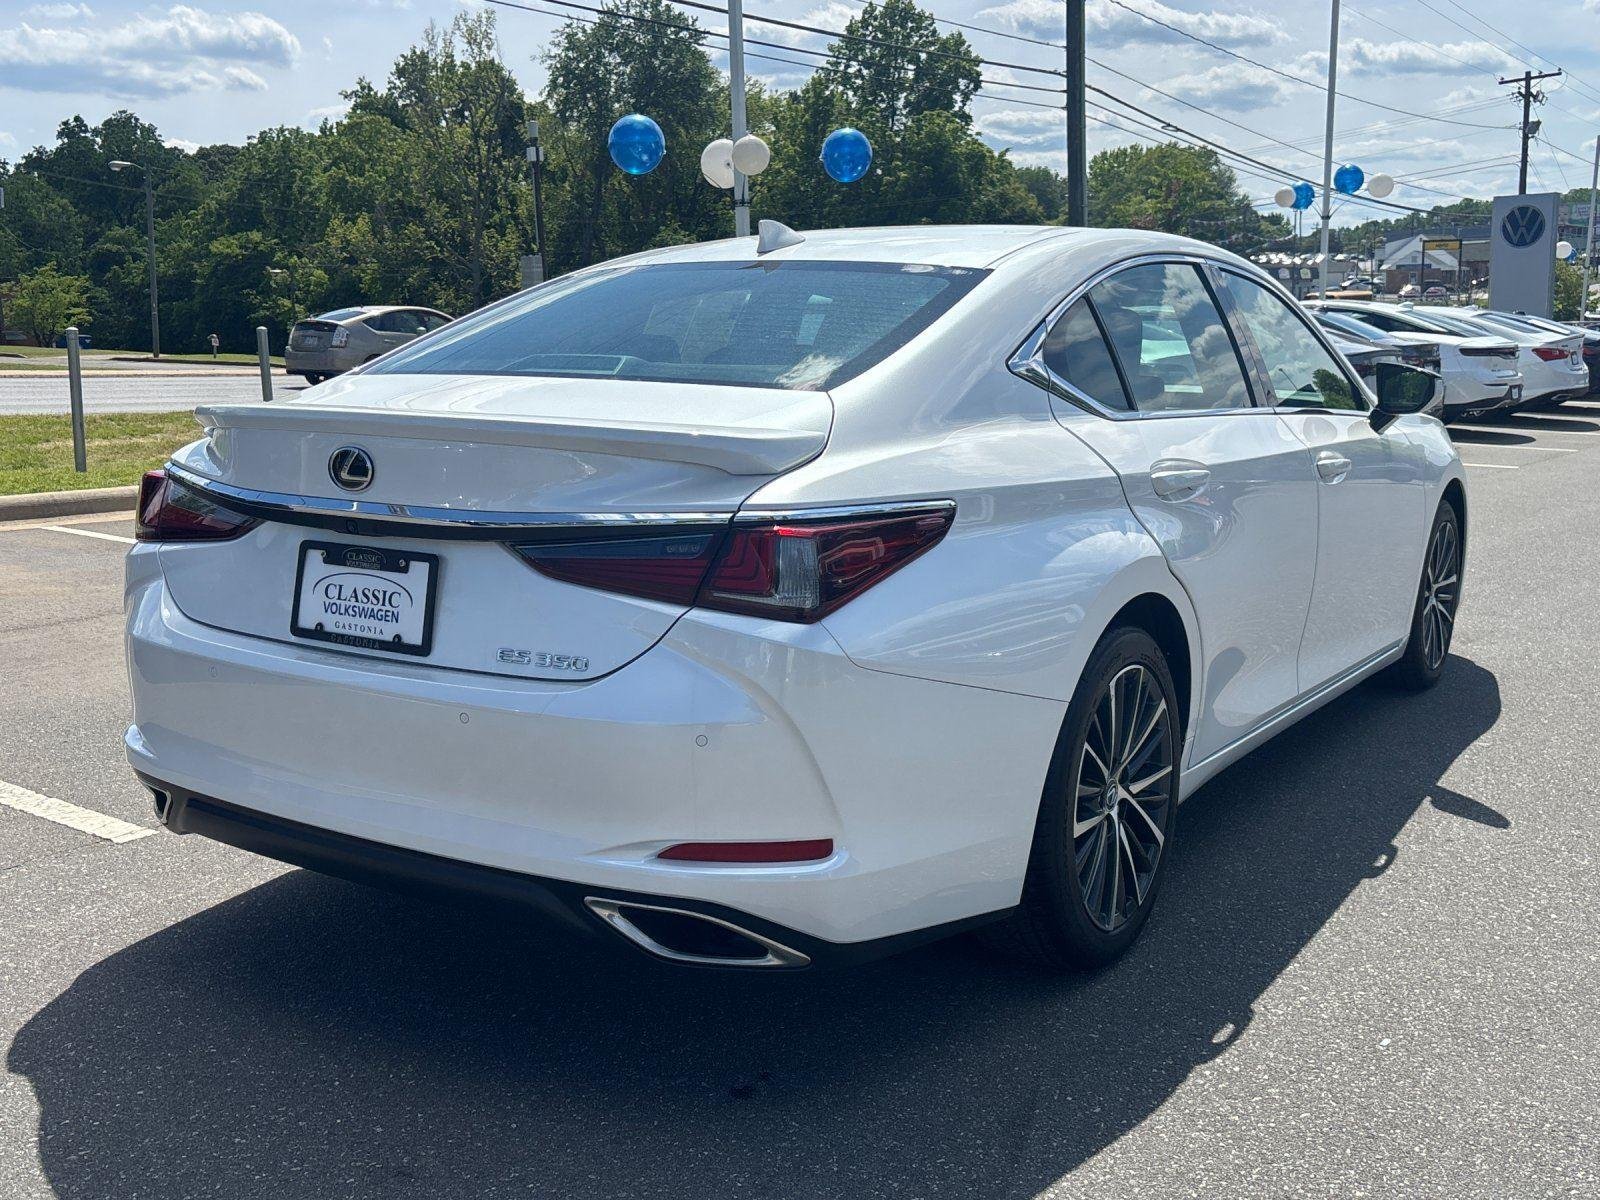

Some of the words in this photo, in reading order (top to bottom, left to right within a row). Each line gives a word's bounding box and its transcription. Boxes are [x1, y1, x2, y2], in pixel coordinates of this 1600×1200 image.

[347, 552, 382, 564] CLASSIC
[324, 583, 402, 608] CLASSIC
[323, 601, 400, 623] VOLKSWAGEN
[334, 621, 384, 635] GASTONIA
[329, 634, 381, 649] GASTONIA
[497, 648, 531, 665] ES
[535, 652, 590, 672] 350
